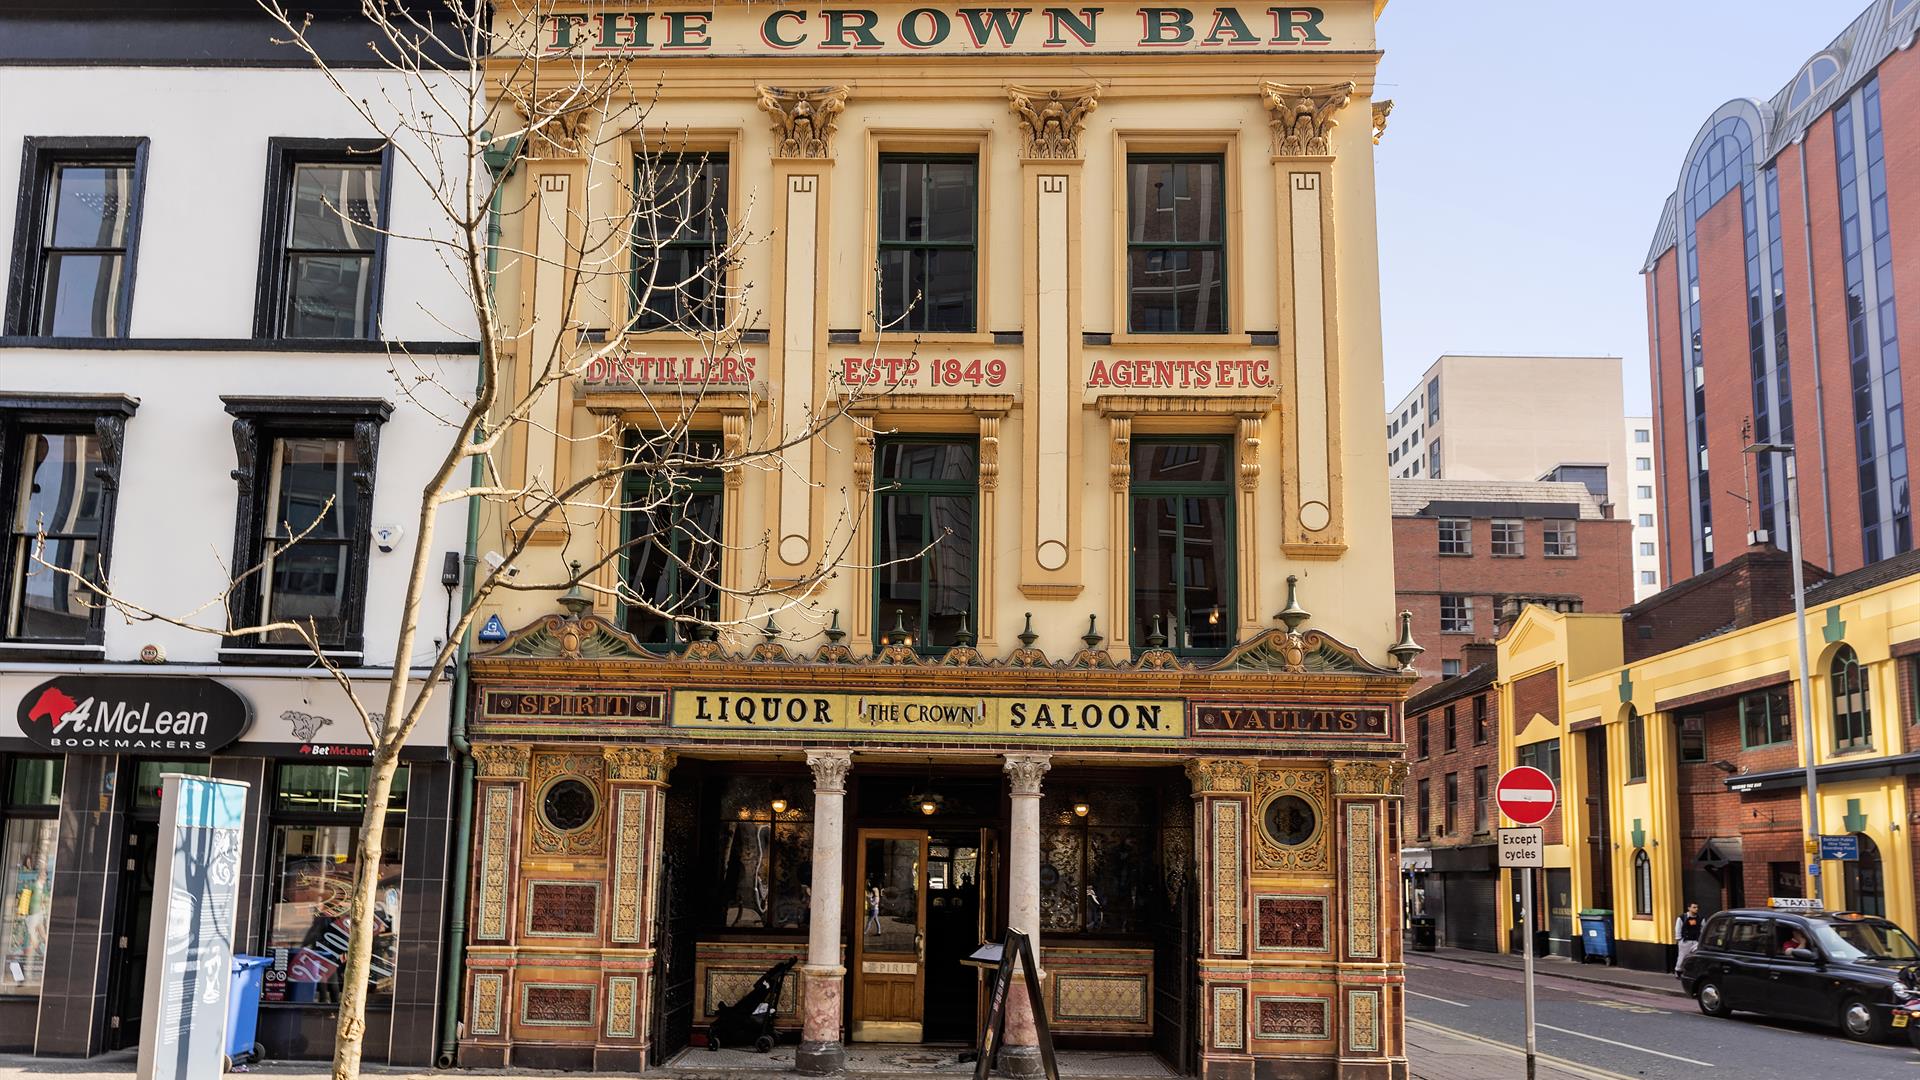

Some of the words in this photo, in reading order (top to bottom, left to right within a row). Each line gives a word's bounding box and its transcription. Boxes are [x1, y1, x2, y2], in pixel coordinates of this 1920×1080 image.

[539, 10, 714, 52] THE
[761, 7, 1104, 50] CROWN
[1137, 6, 1331, 48] BAR
[584, 356, 757, 386] DISTILLERS
[931, 358, 1007, 387] 1849
[1088, 358, 1213, 388] AGENTS
[520, 695, 630, 715] SPIRIT
[696, 696, 833, 724] LIQUOR
[868, 704, 898, 722] THE
[904, 703, 976, 723] CROWN
[1221, 709, 1359, 731] VAULTS
[50, 738, 206, 749] BOOKMAKERS
[1503, 834, 1537, 846] Except
[1505, 849, 1536, 861] cycles
[1782, 898, 1808, 907] TAXI
